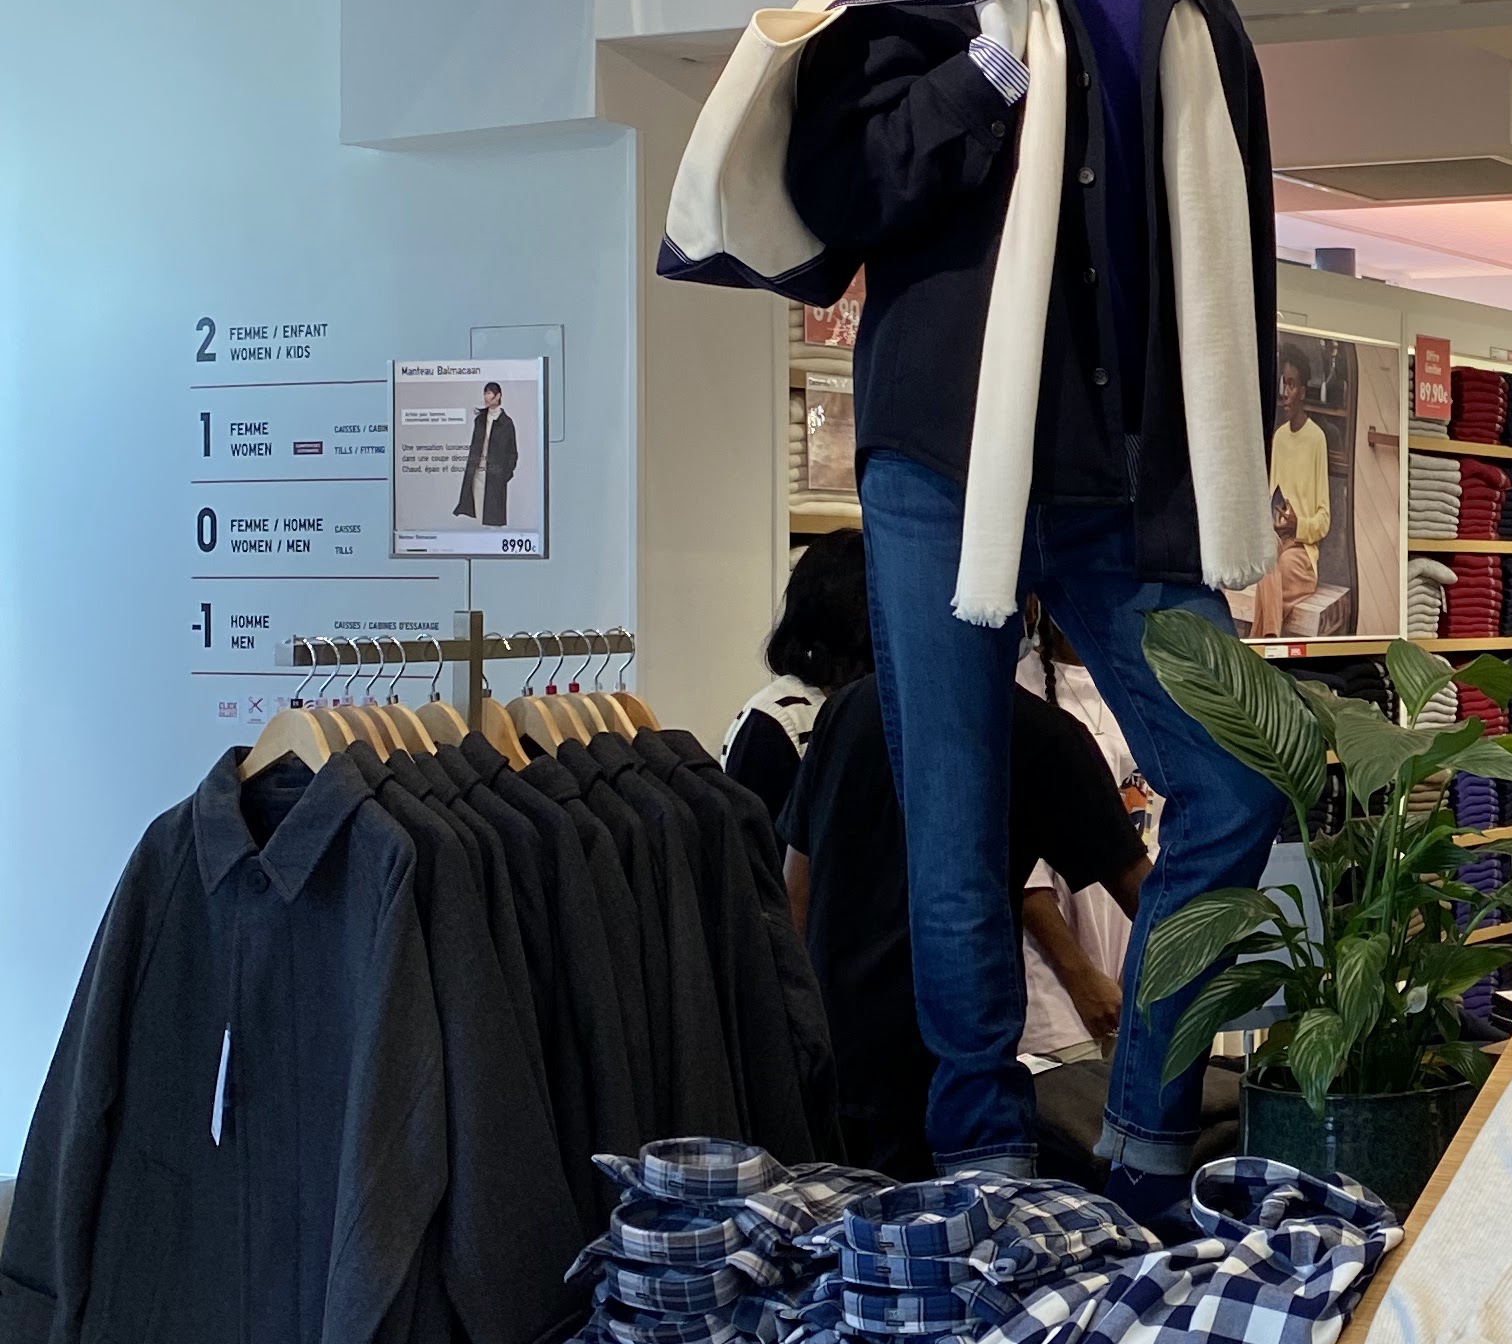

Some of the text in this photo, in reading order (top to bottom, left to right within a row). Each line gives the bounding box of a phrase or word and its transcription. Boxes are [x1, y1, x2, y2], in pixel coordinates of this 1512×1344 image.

[229, 326, 269, 340] FEMME
[283, 323, 328, 338] ENFANT
[195, 316, 217, 362] 2
[230, 347, 272, 361] WOMEN
[286, 345, 311, 359] KIDS
[401, 365, 481, 376] Manteau Balmacaan
[200, 412, 211, 457] 1
[230, 422, 269, 436] FEMME
[230, 443, 272, 456] WOMEN
[197, 507, 217, 552] 0
[230, 519, 269, 532] FEMME
[283, 518, 323, 532] HOMME
[231, 539, 272, 553] WOMEN
[286, 539, 310, 553] MEN
[192, 603, 212, 648] -1
[231, 615, 270, 629] HOMME
[231, 636, 255, 650] MEN
